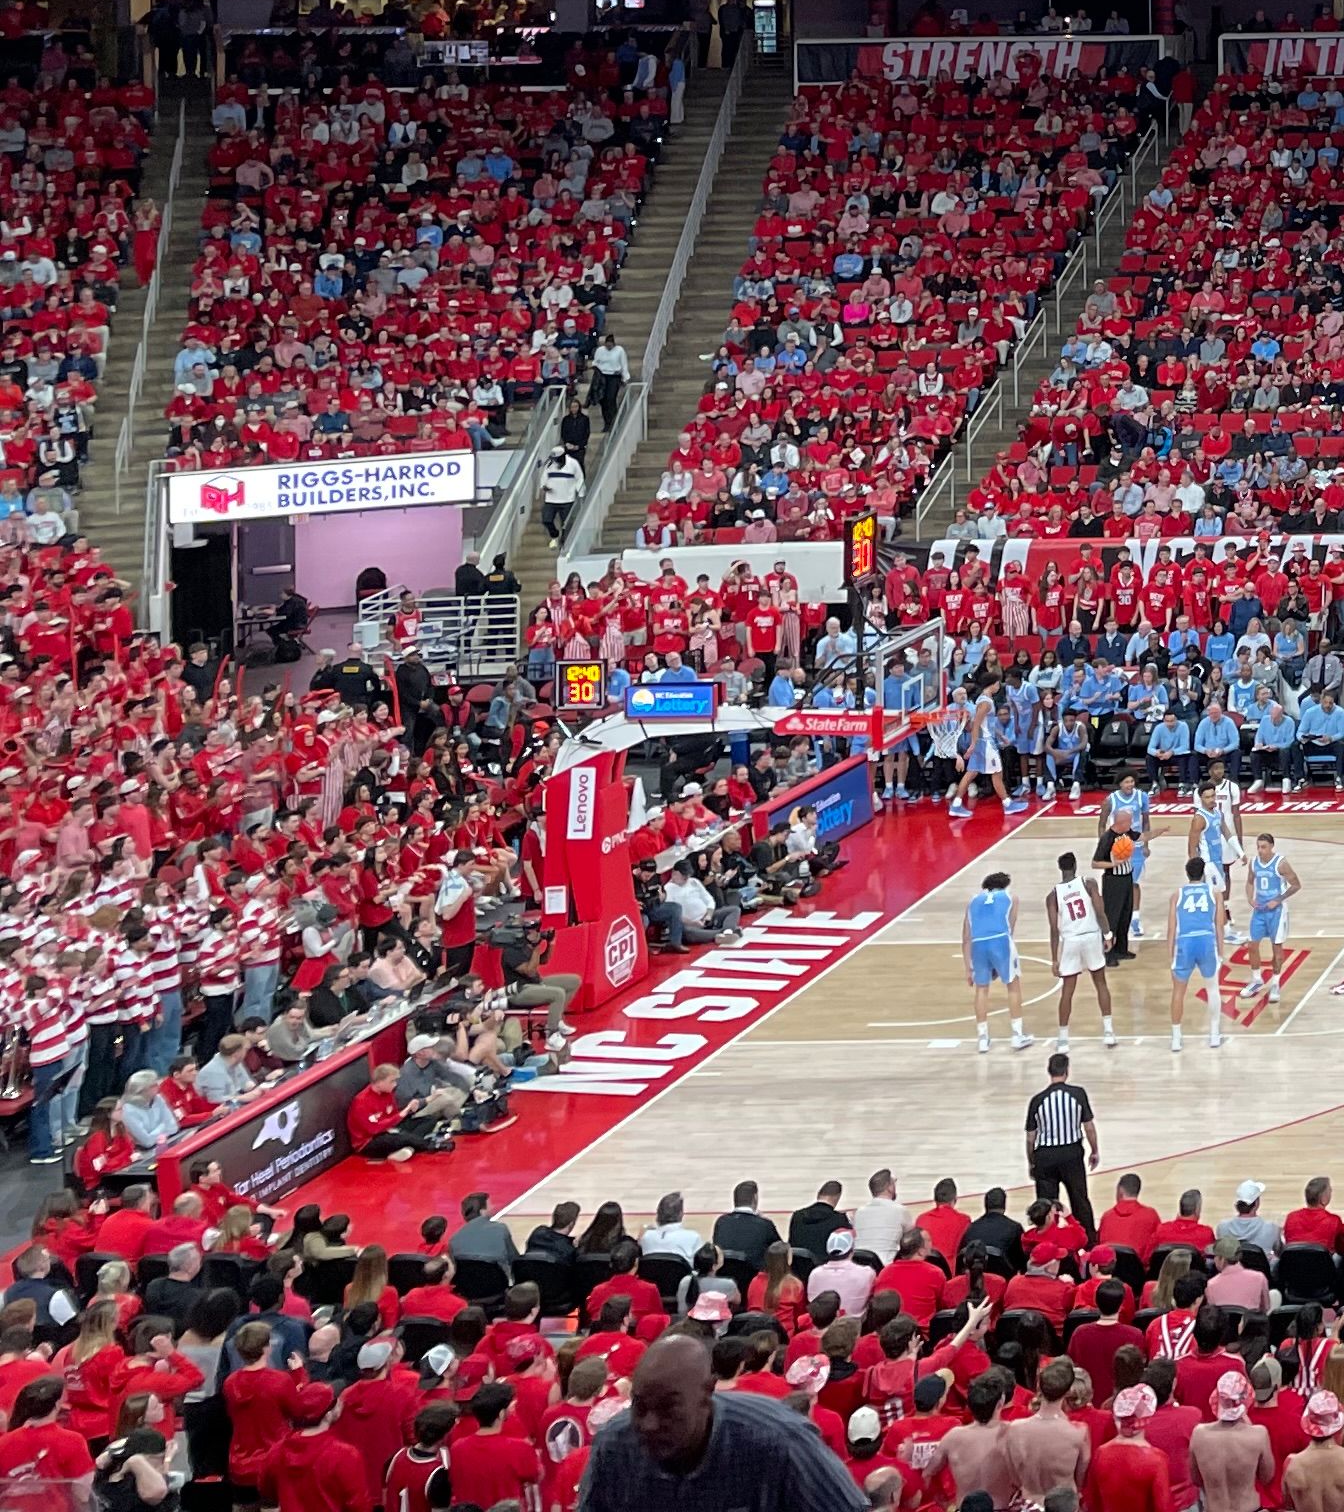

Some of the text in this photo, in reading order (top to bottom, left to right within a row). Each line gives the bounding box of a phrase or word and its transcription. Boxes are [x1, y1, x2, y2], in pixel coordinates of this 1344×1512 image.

[881, 40, 1083, 83] STRENGTH
[1265, 38, 1304, 76] IN
[278, 461, 460, 491] RIGGS-HARROD
[569, 682, 595, 703] 30
[656, 698, 708, 713] Lottery
[573, 774, 588, 834] Lenovo
[1238, 801, 1273, 811] IN
[1281, 801, 1333, 811] THE
[1260, 875, 1269, 891] 0
[1067, 900, 1087, 921] 13
[1184, 893, 1209, 913] 44
[608, 940, 636, 967] CPI
[513, 909, 884, 1096] NC STATE
[251, 1163, 276, 1189] Heel
